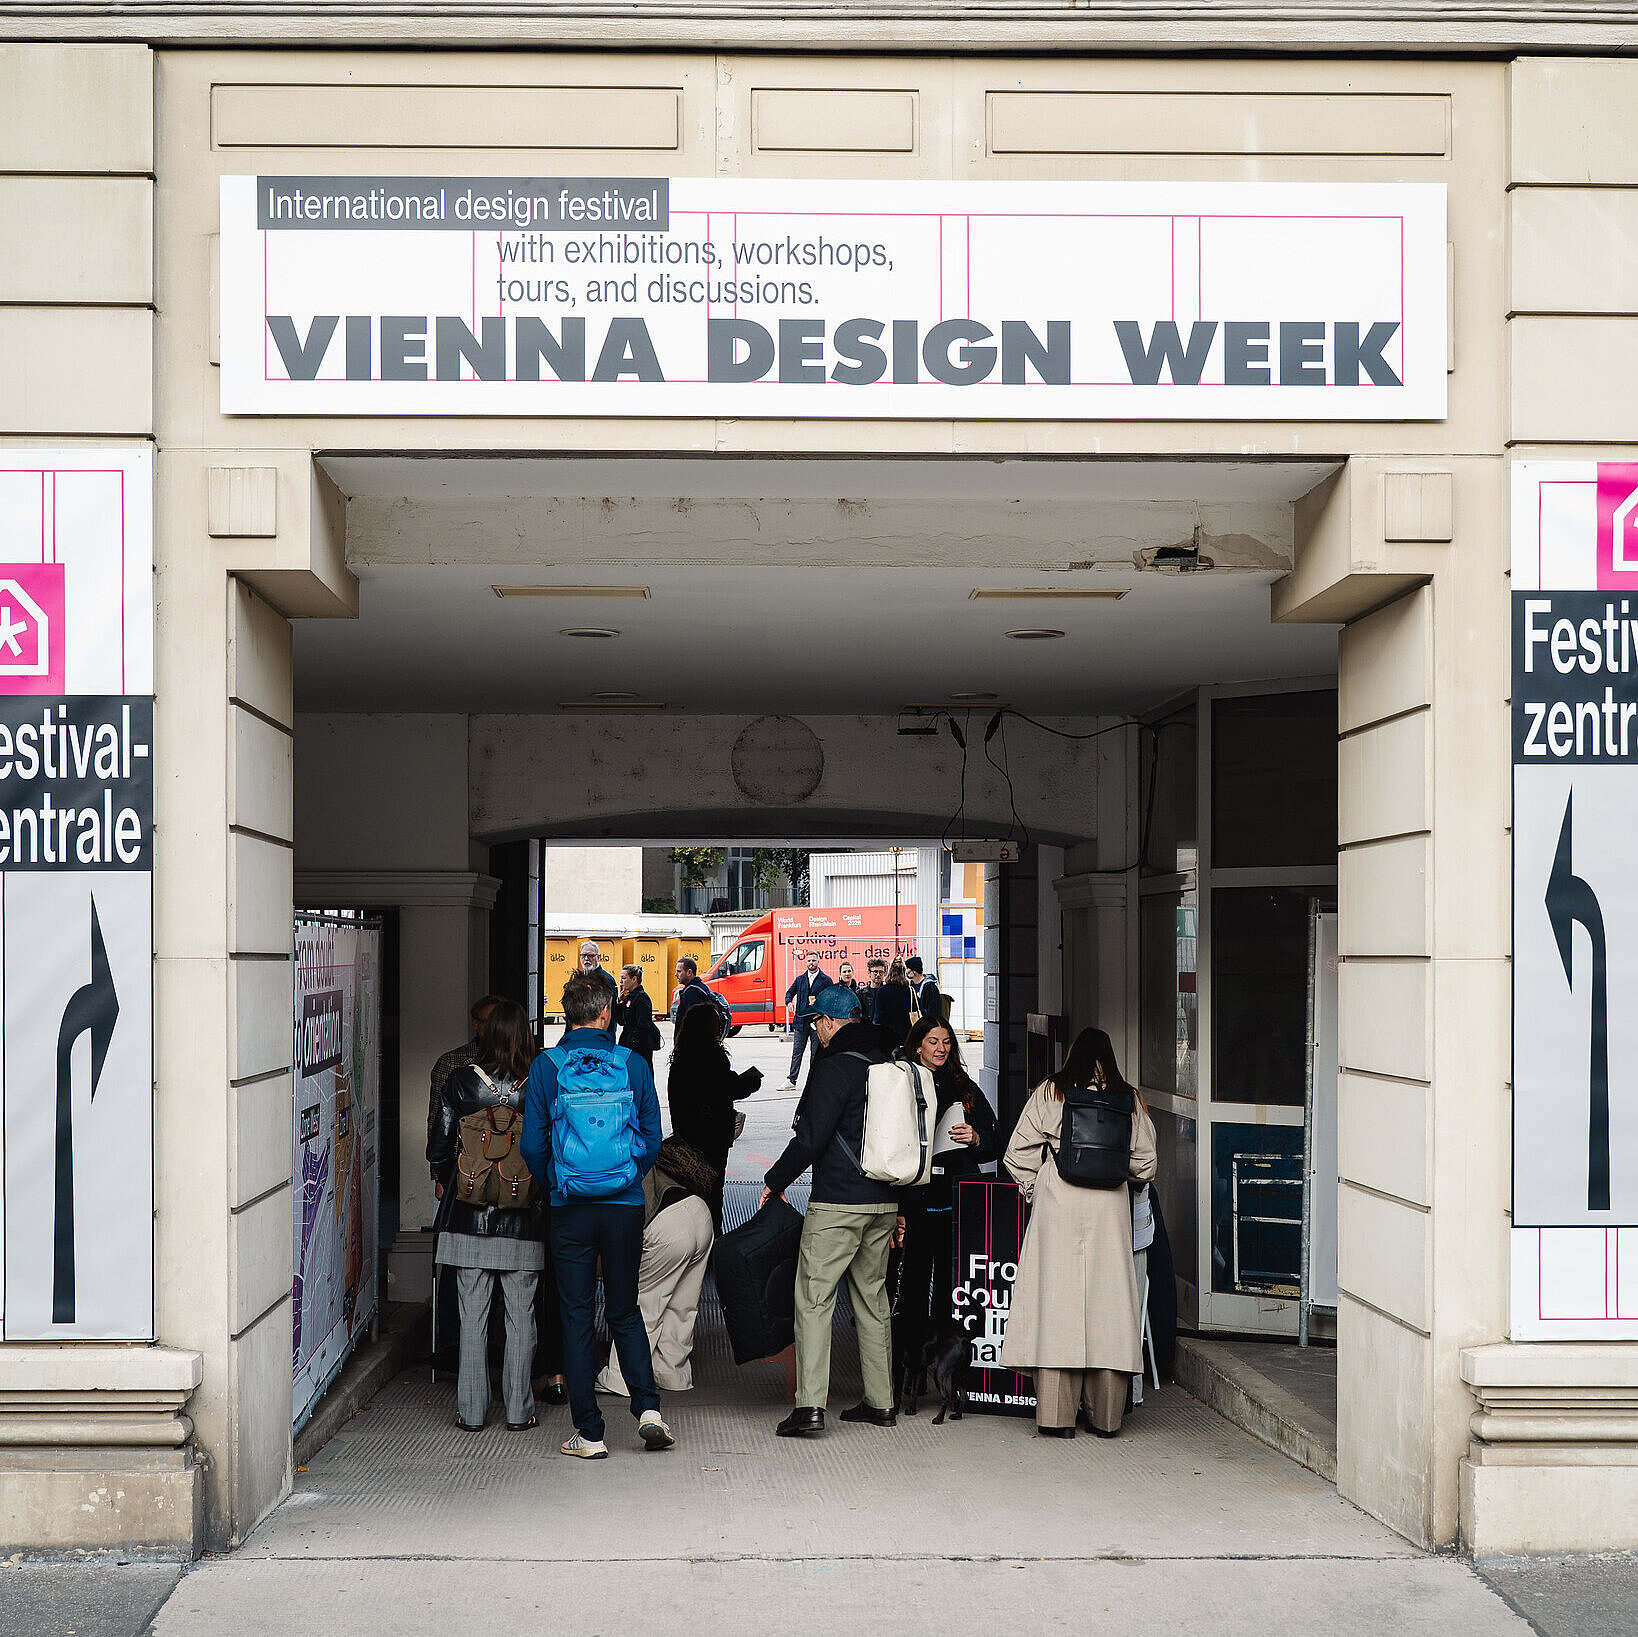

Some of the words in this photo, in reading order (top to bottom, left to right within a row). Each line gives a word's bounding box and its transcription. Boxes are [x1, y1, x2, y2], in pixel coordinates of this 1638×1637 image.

[268, 187, 445, 220] International
[454, 189, 549, 228] design
[558, 189, 658, 223] festival
[496, 235, 555, 264] with
[564, 236, 723, 269] exhibitions,
[732, 236, 894, 273] workshops,
[497, 274, 577, 307] tours,
[586, 276, 638, 304] and
[648, 276, 820, 306] discussions.
[265, 314, 666, 383] VIENNA
[708, 318, 1071, 386] DESIGN
[1113, 320, 1404, 387] WEEK
[1523, 686, 1638, 757] zentr
[864, 945, 890, 959] das
[952, 1280, 1014, 1308] dou
[1004, 1394, 1038, 1407] DESIG
